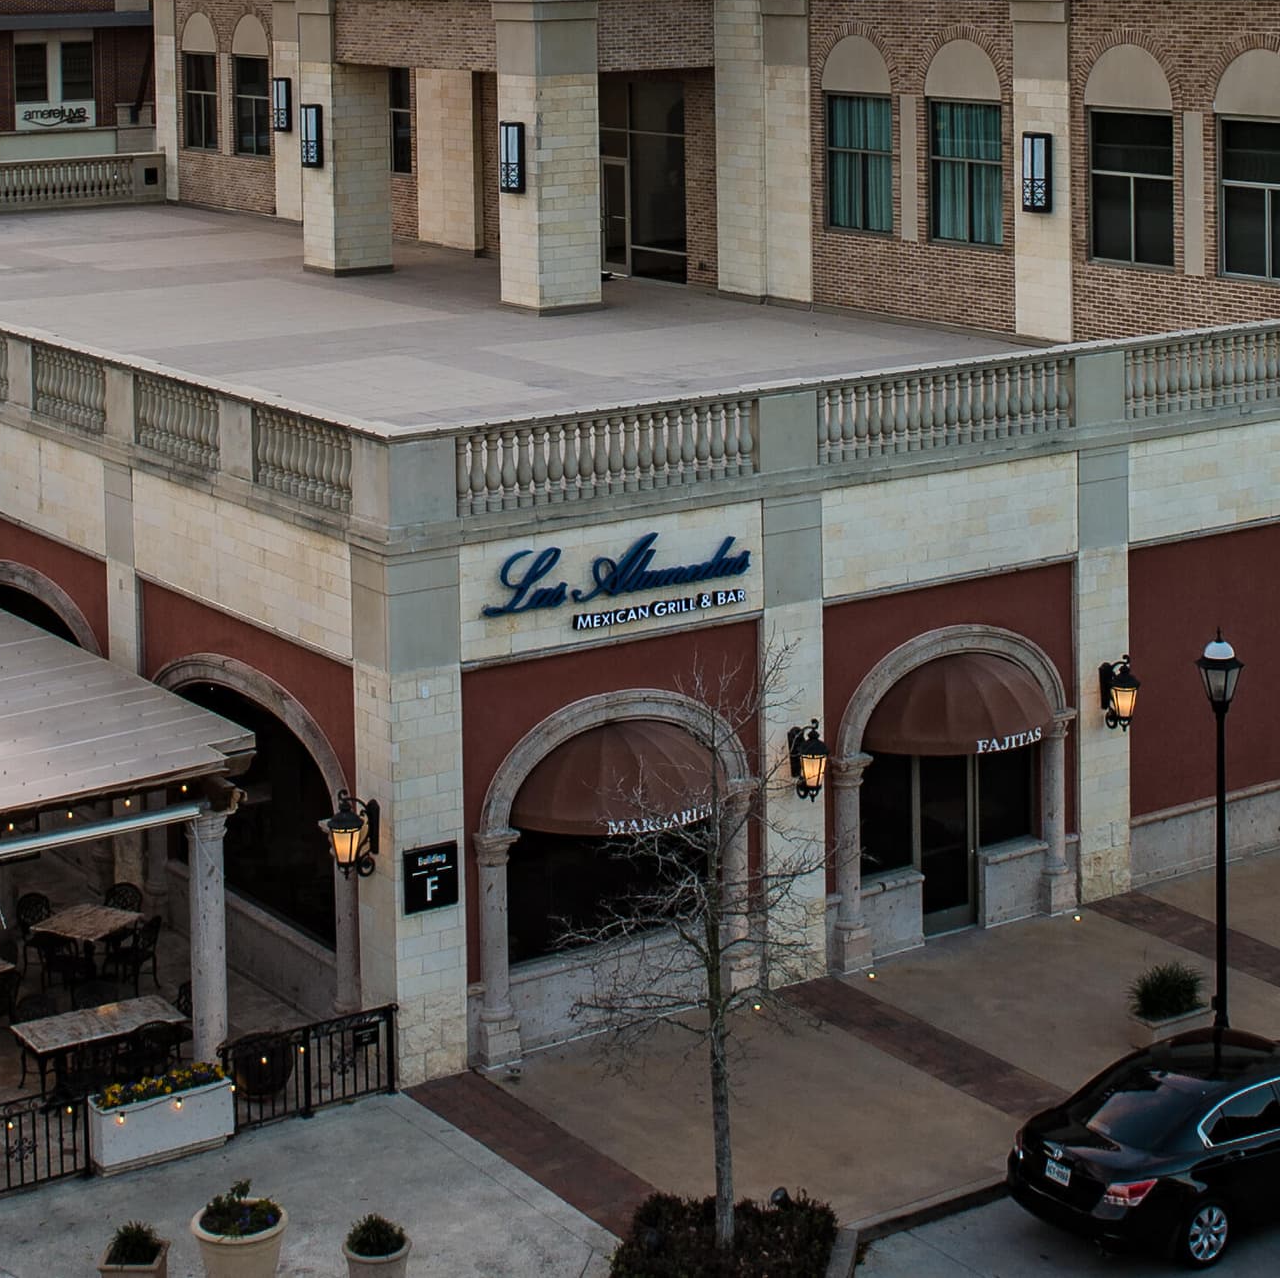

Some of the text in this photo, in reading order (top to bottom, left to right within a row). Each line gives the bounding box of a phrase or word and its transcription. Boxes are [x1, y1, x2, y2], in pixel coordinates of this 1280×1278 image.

[22, 105, 87, 120] amerejuve
[483, 532, 752, 618] Las Alamedas
[574, 589, 746, 631] MEXICAN GRILL & BAR
[975, 726, 1042, 754] FAJITAS
[426, 875, 439, 902] F
